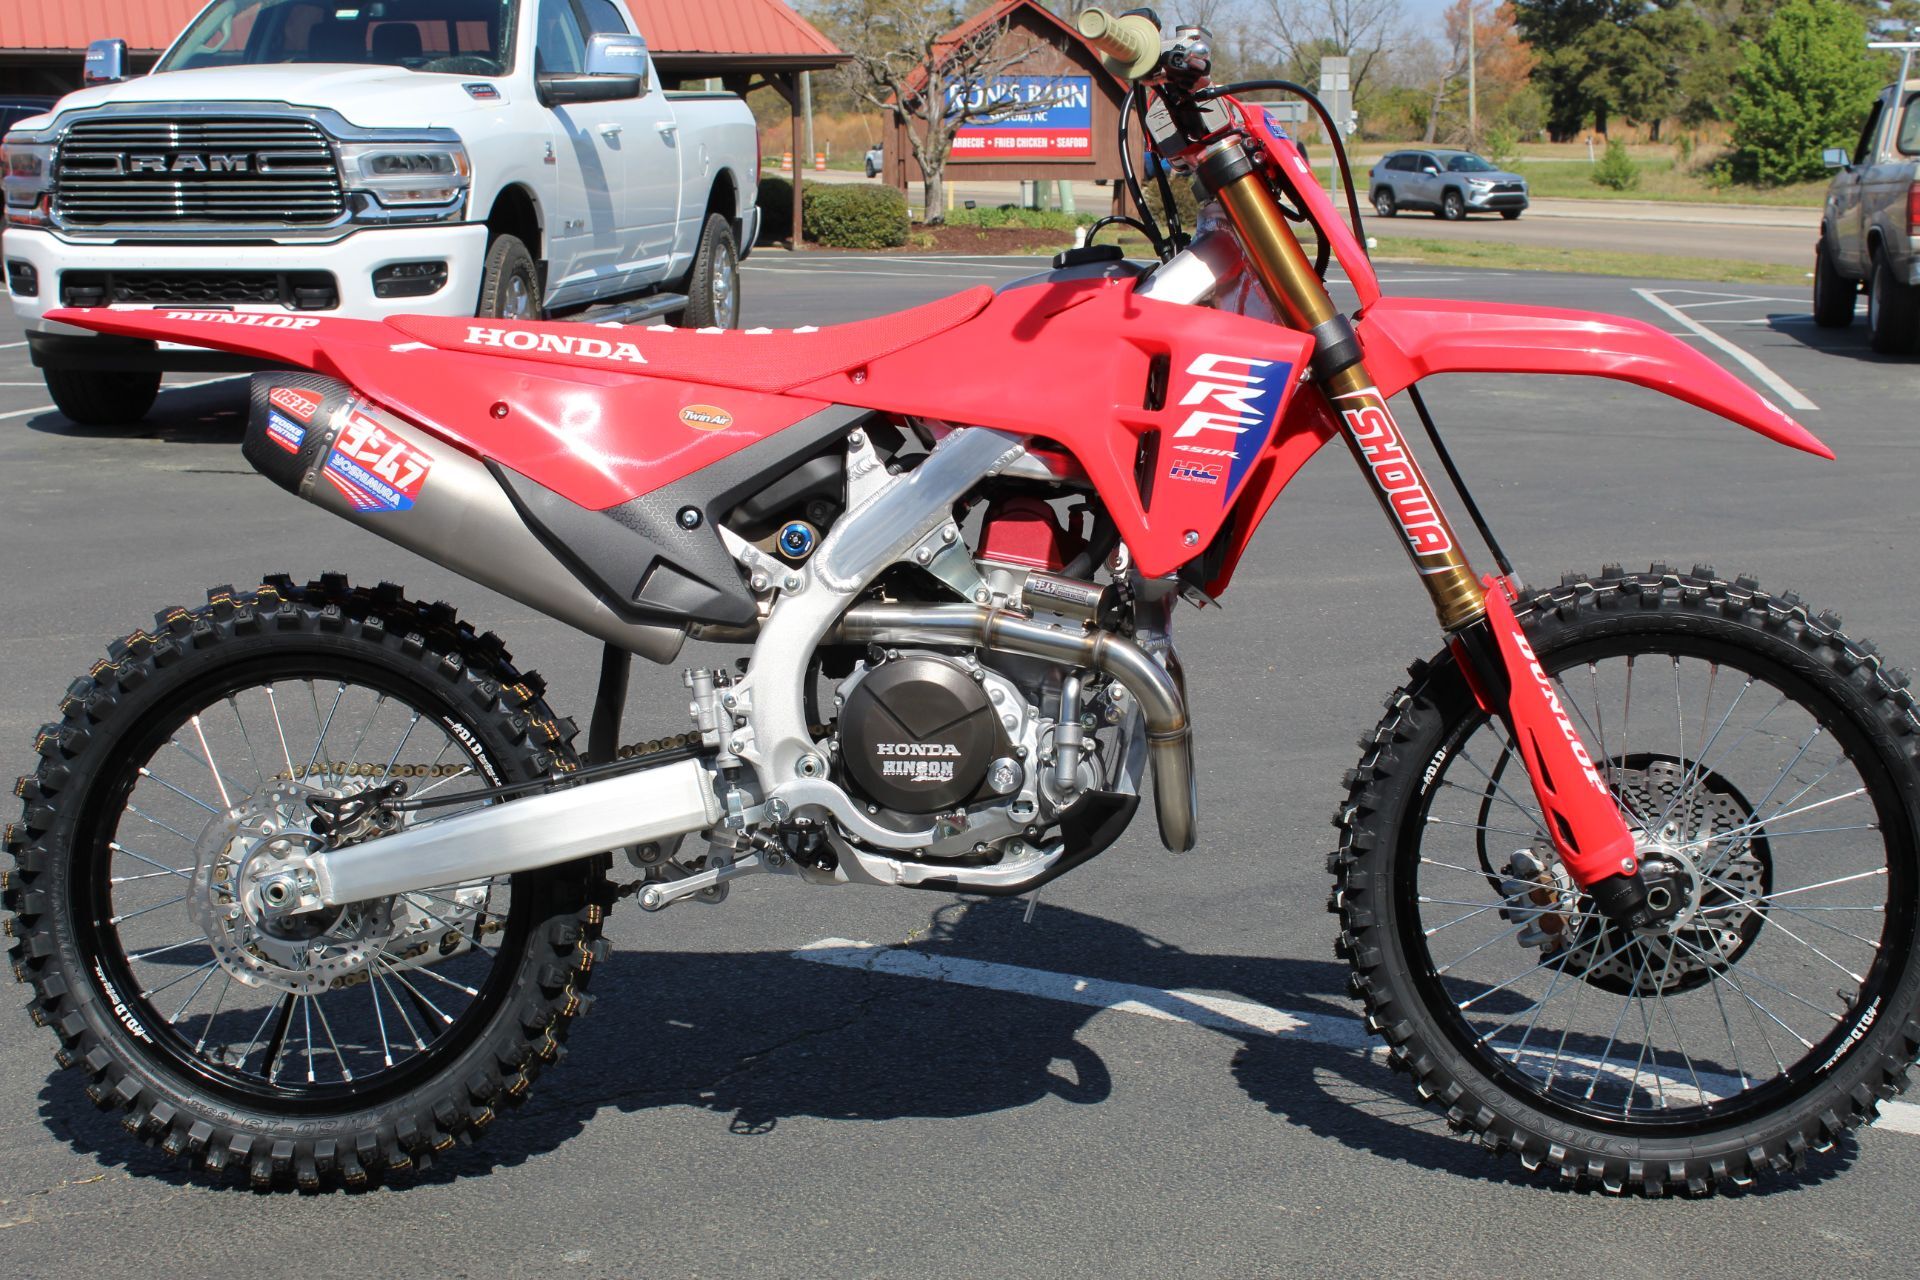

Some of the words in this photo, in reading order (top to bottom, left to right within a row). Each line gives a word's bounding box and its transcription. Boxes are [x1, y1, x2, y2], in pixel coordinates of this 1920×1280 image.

[1035, 112, 1048, 121] NC
[952, 137, 985, 148] ARBECUE
[994, 137, 1015, 148] FRIED
[1016, 137, 1048, 148] CHICKEN
[1056, 137, 1088, 148] SEAFOOD
[130, 154, 248, 172] RAM
[164, 311, 321, 330] DUNLOP
[464, 327, 648, 364] HONDA
[271, 388, 318, 418] RS12
[685, 410, 710, 422] Twin
[710, 414, 730, 425] Air
[270, 423, 300, 443] EDITION
[1173, 445, 1240, 460] 450R
[332, 453, 401, 505] YOSHIMURA
[1170, 460, 1222, 480] HRC
[1342, 406, 1453, 556] SHOWA
[1512, 631, 1607, 795] DUNLOP
[877, 744, 961, 756] HONDA
[883, 761, 954, 773] HINSON
